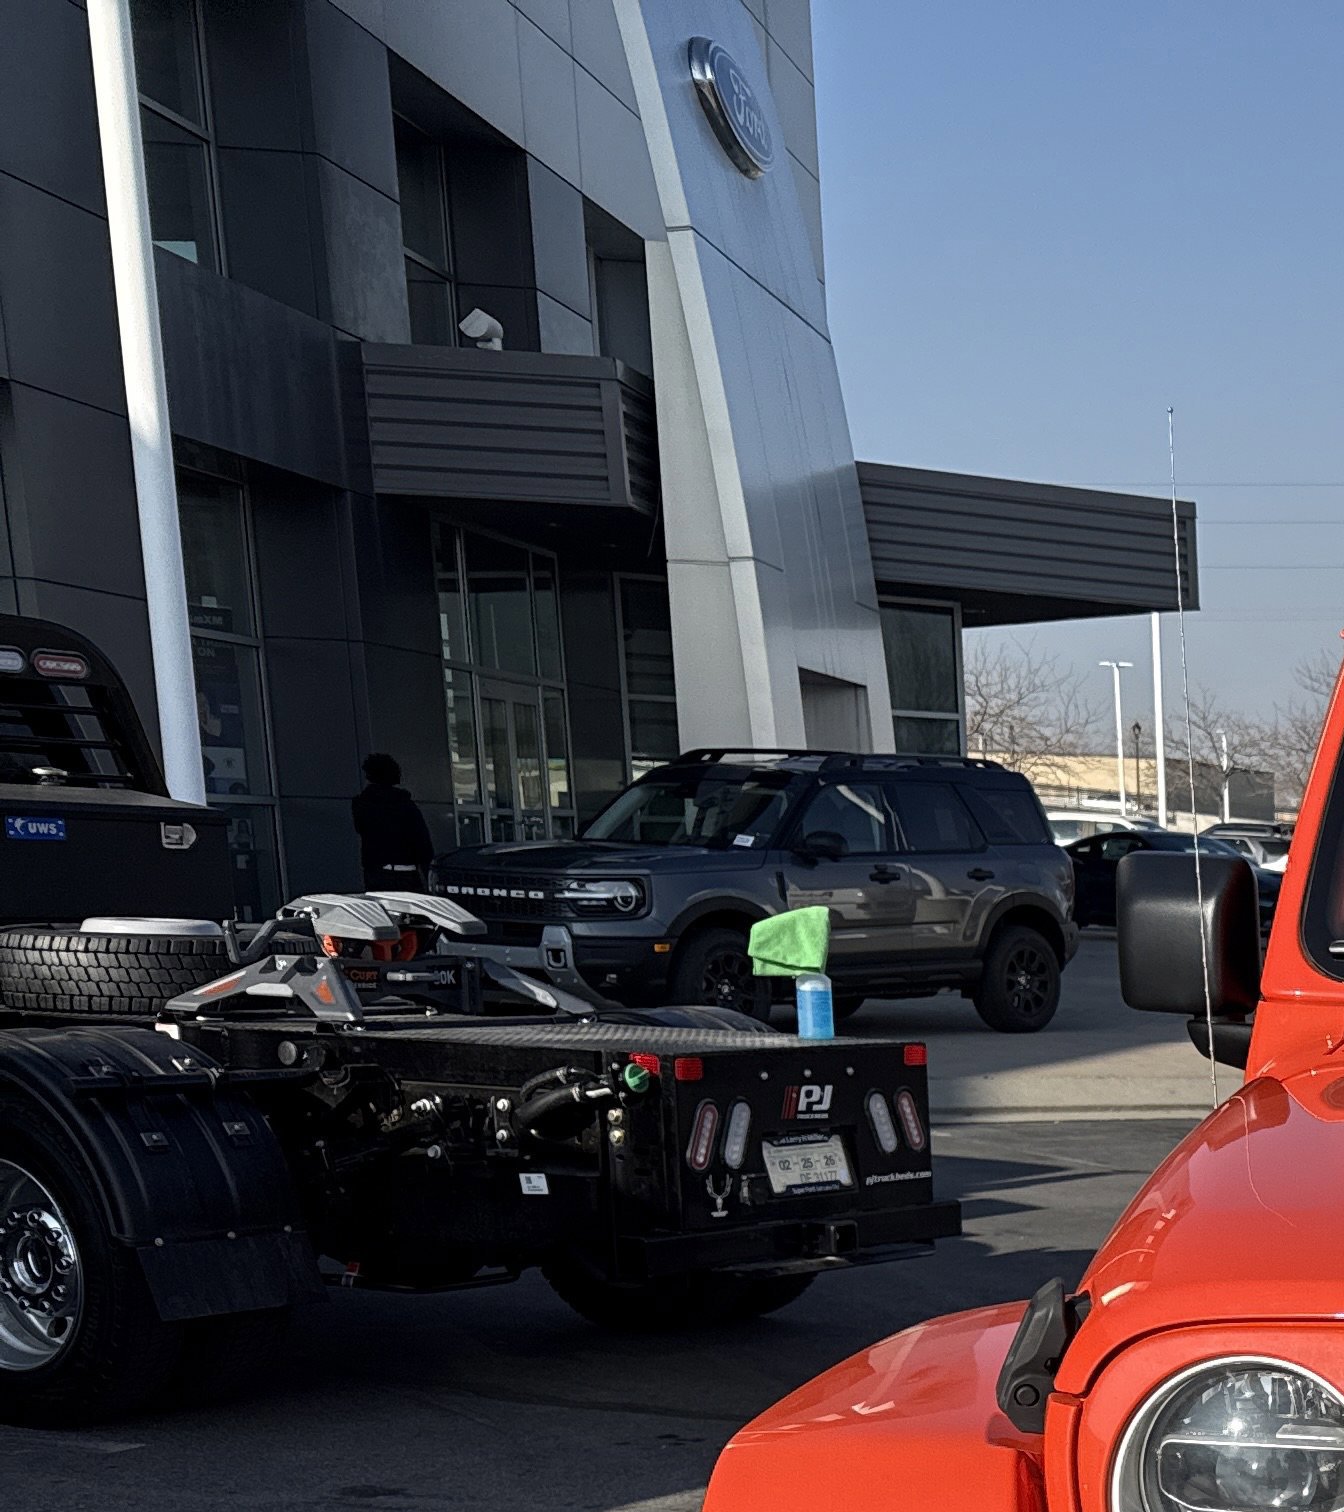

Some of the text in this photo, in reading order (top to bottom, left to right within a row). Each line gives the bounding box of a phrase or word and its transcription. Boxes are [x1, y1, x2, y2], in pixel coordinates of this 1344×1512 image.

[729, 69, 768, 148] Ford
[27, 822, 57, 835] UWS
[446, 885, 545, 899] BRONCO
[797, 1084, 834, 1112] PJ
[778, 1159, 792, 1171] 02
[801, 1157, 814, 1169] 25
